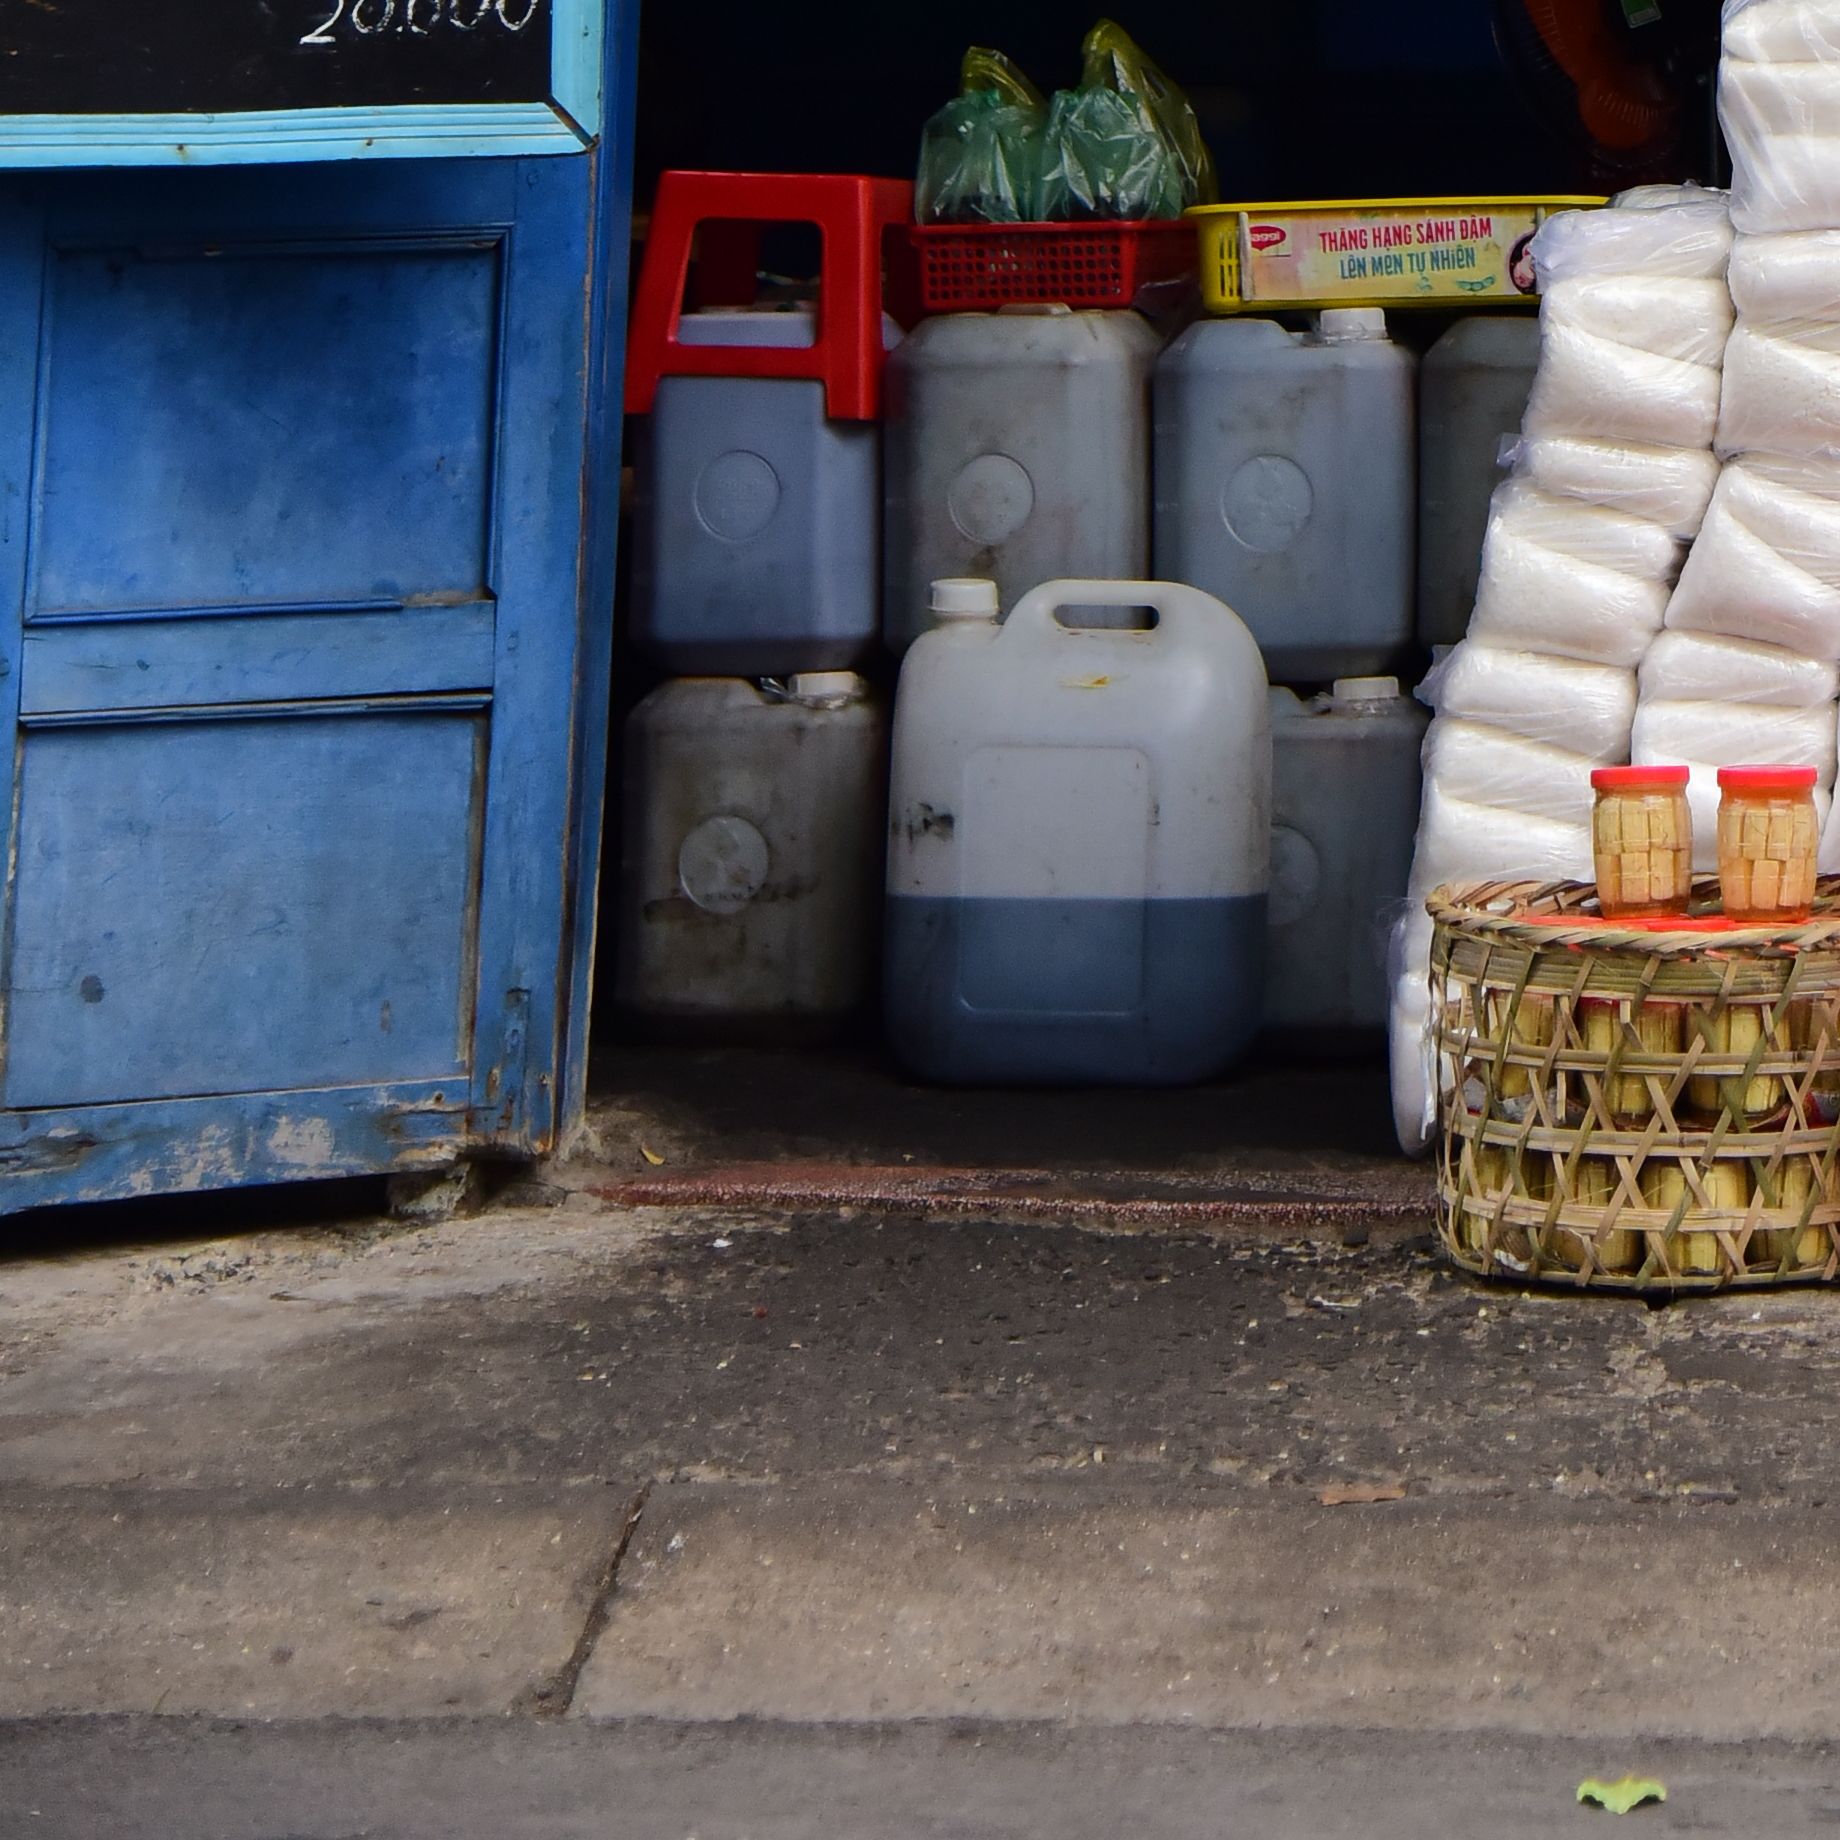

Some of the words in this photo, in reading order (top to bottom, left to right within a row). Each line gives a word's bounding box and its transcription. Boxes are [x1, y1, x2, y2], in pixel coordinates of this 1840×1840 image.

[1251, 231, 1281, 243] aggi
[1371, 223, 1413, 252] HẠNG
[1416, 218, 1456, 245] SÁNH
[1459, 214, 1493, 243] ĐẬM
